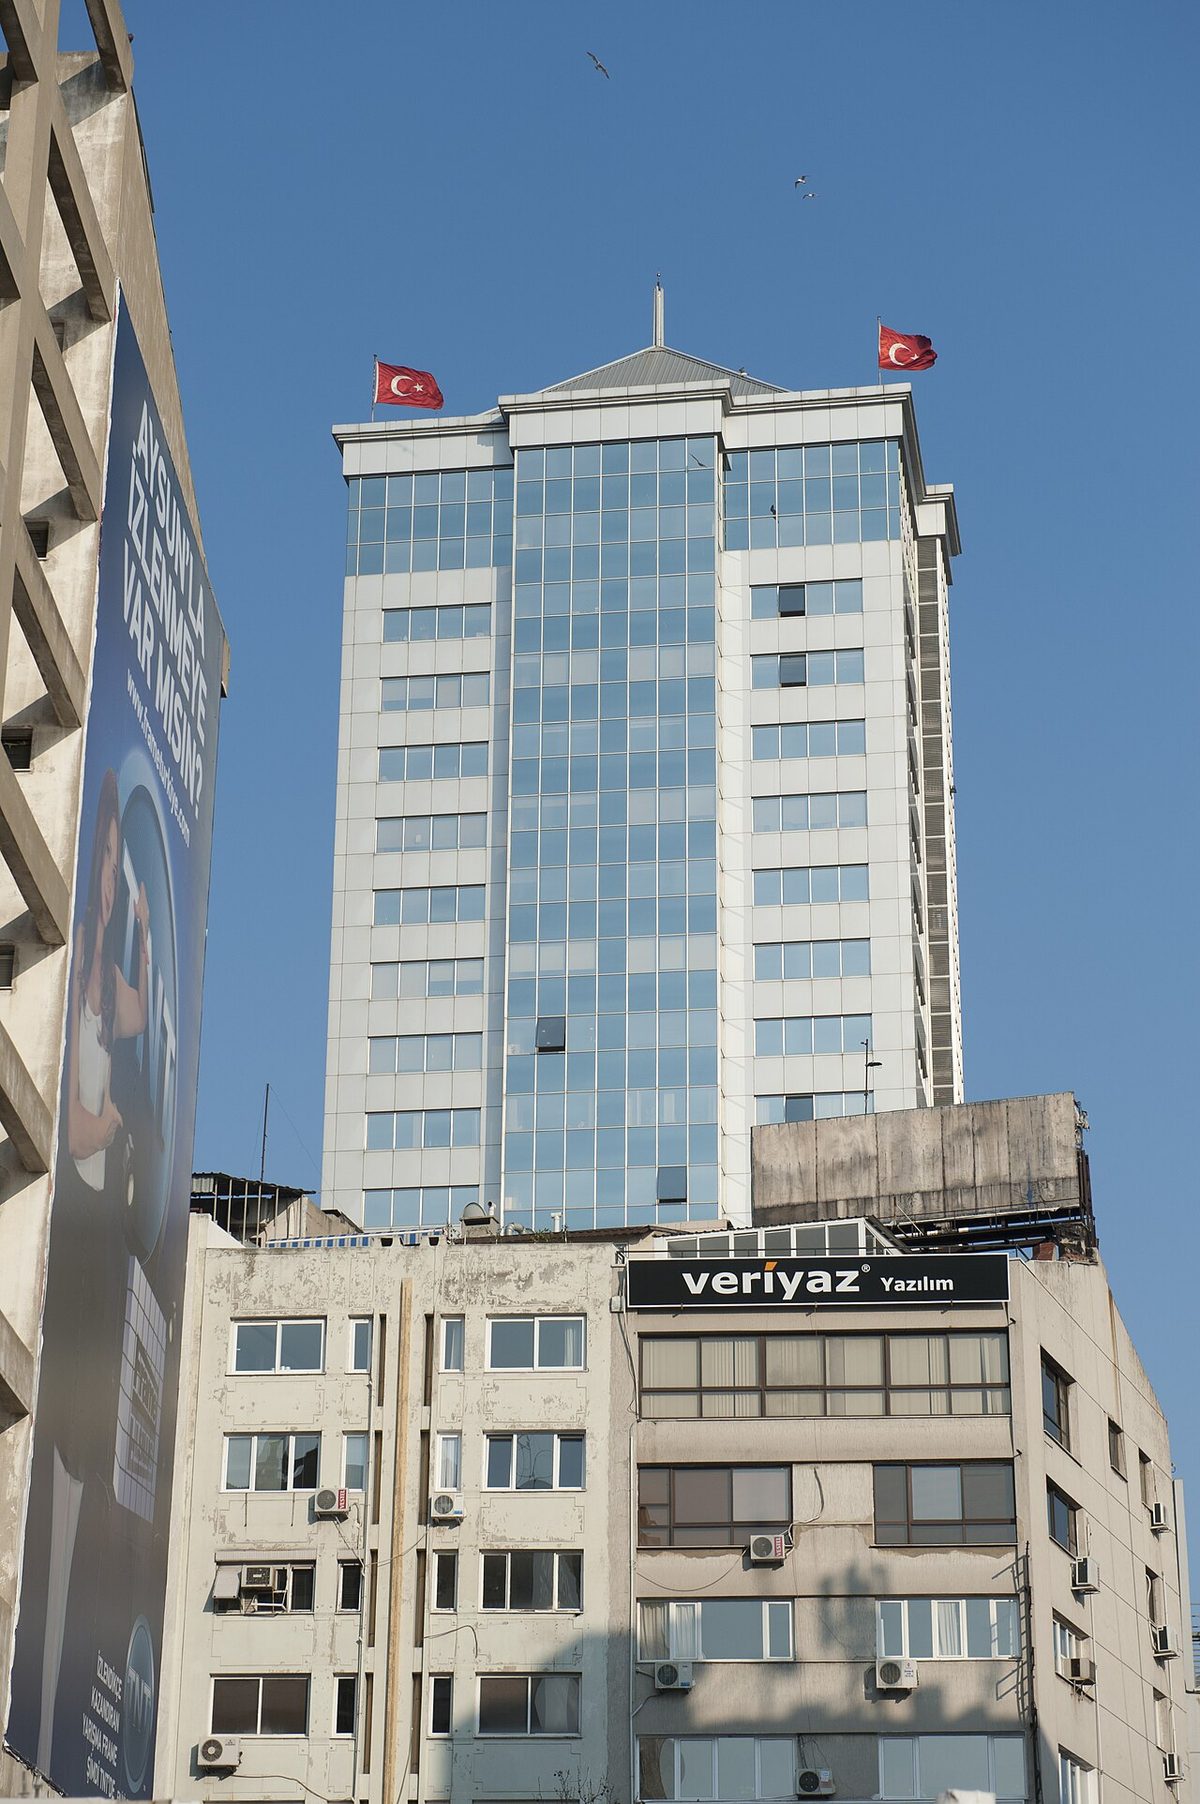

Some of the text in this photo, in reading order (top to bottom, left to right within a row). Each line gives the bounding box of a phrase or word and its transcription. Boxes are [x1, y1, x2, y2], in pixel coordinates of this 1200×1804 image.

[127, 439, 208, 748] İZLENMEYE
[136, 400, 206, 659] AYSUN'LA
[123, 538, 203, 821] VAR MISIN?
[880, 1276, 955, 1293] Yazılım
